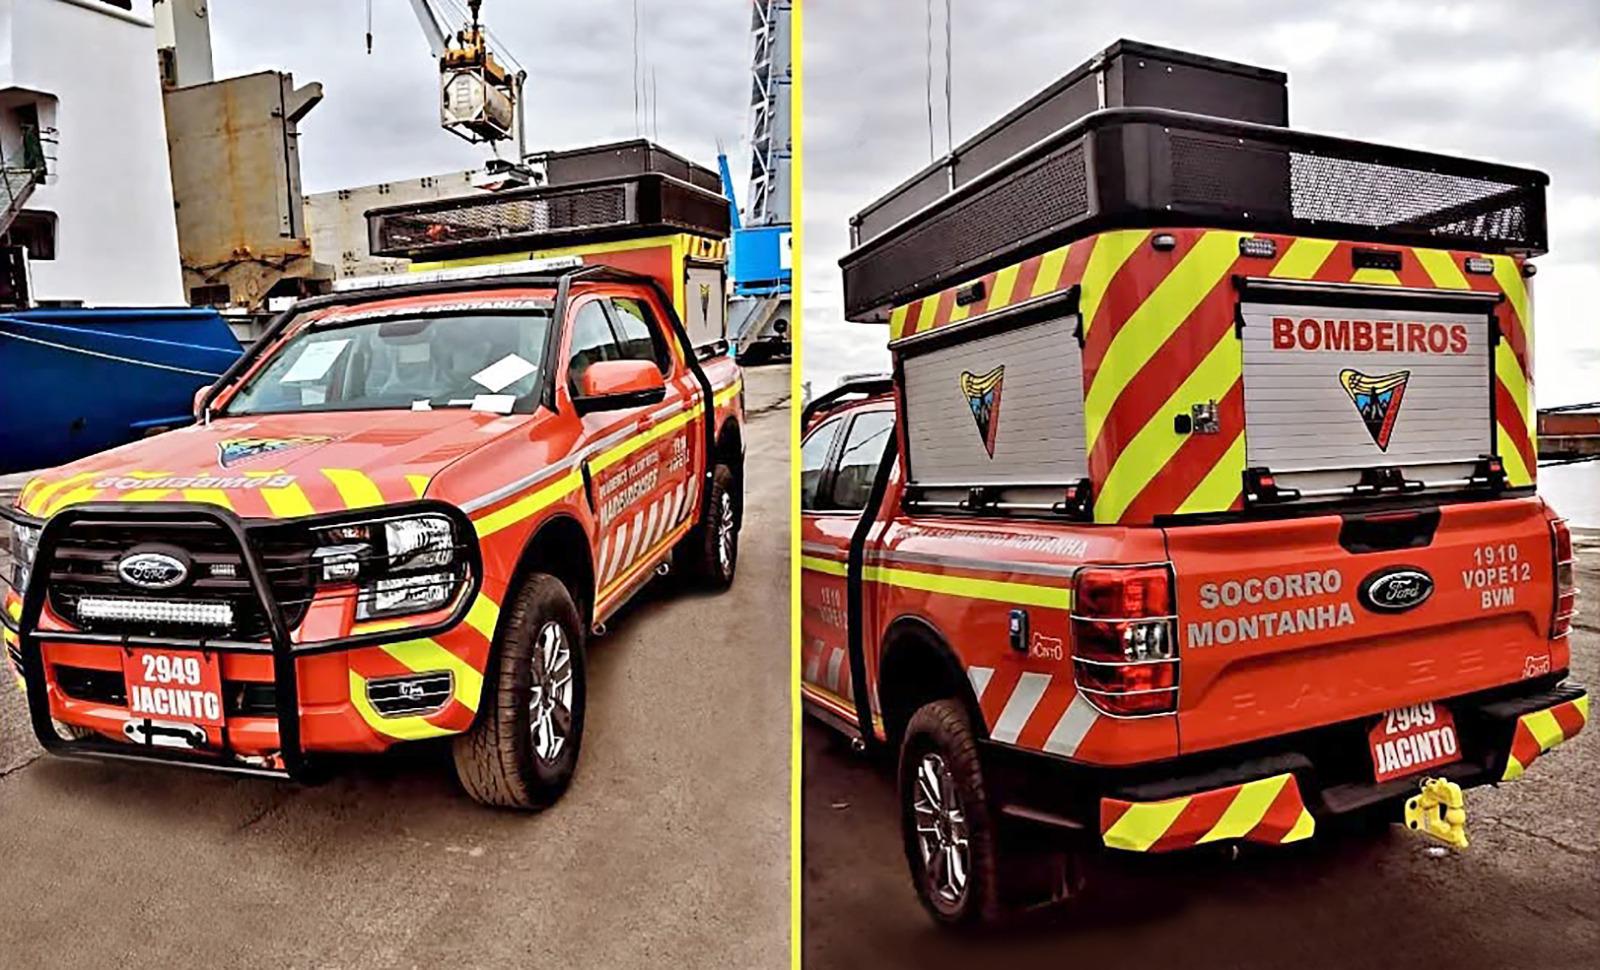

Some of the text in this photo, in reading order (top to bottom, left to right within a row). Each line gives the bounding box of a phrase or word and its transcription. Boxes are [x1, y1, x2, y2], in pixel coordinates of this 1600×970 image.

[1271, 317, 1468, 354] BOMBEIROS
[1473, 544, 1518, 566] 1910
[1199, 568, 1343, 610] SOCORRO
[1385, 579, 1421, 602] Ford
[1462, 562, 1531, 590] VOPE12
[1481, 586, 1515, 609] BVM
[1187, 602, 1356, 649] MONTANHA
[142, 654, 201, 686] 2949
[131, 685, 220, 720] JACINTO
[1383, 702, 1436, 735] 2949
[1375, 726, 1457, 774] JACINTO
